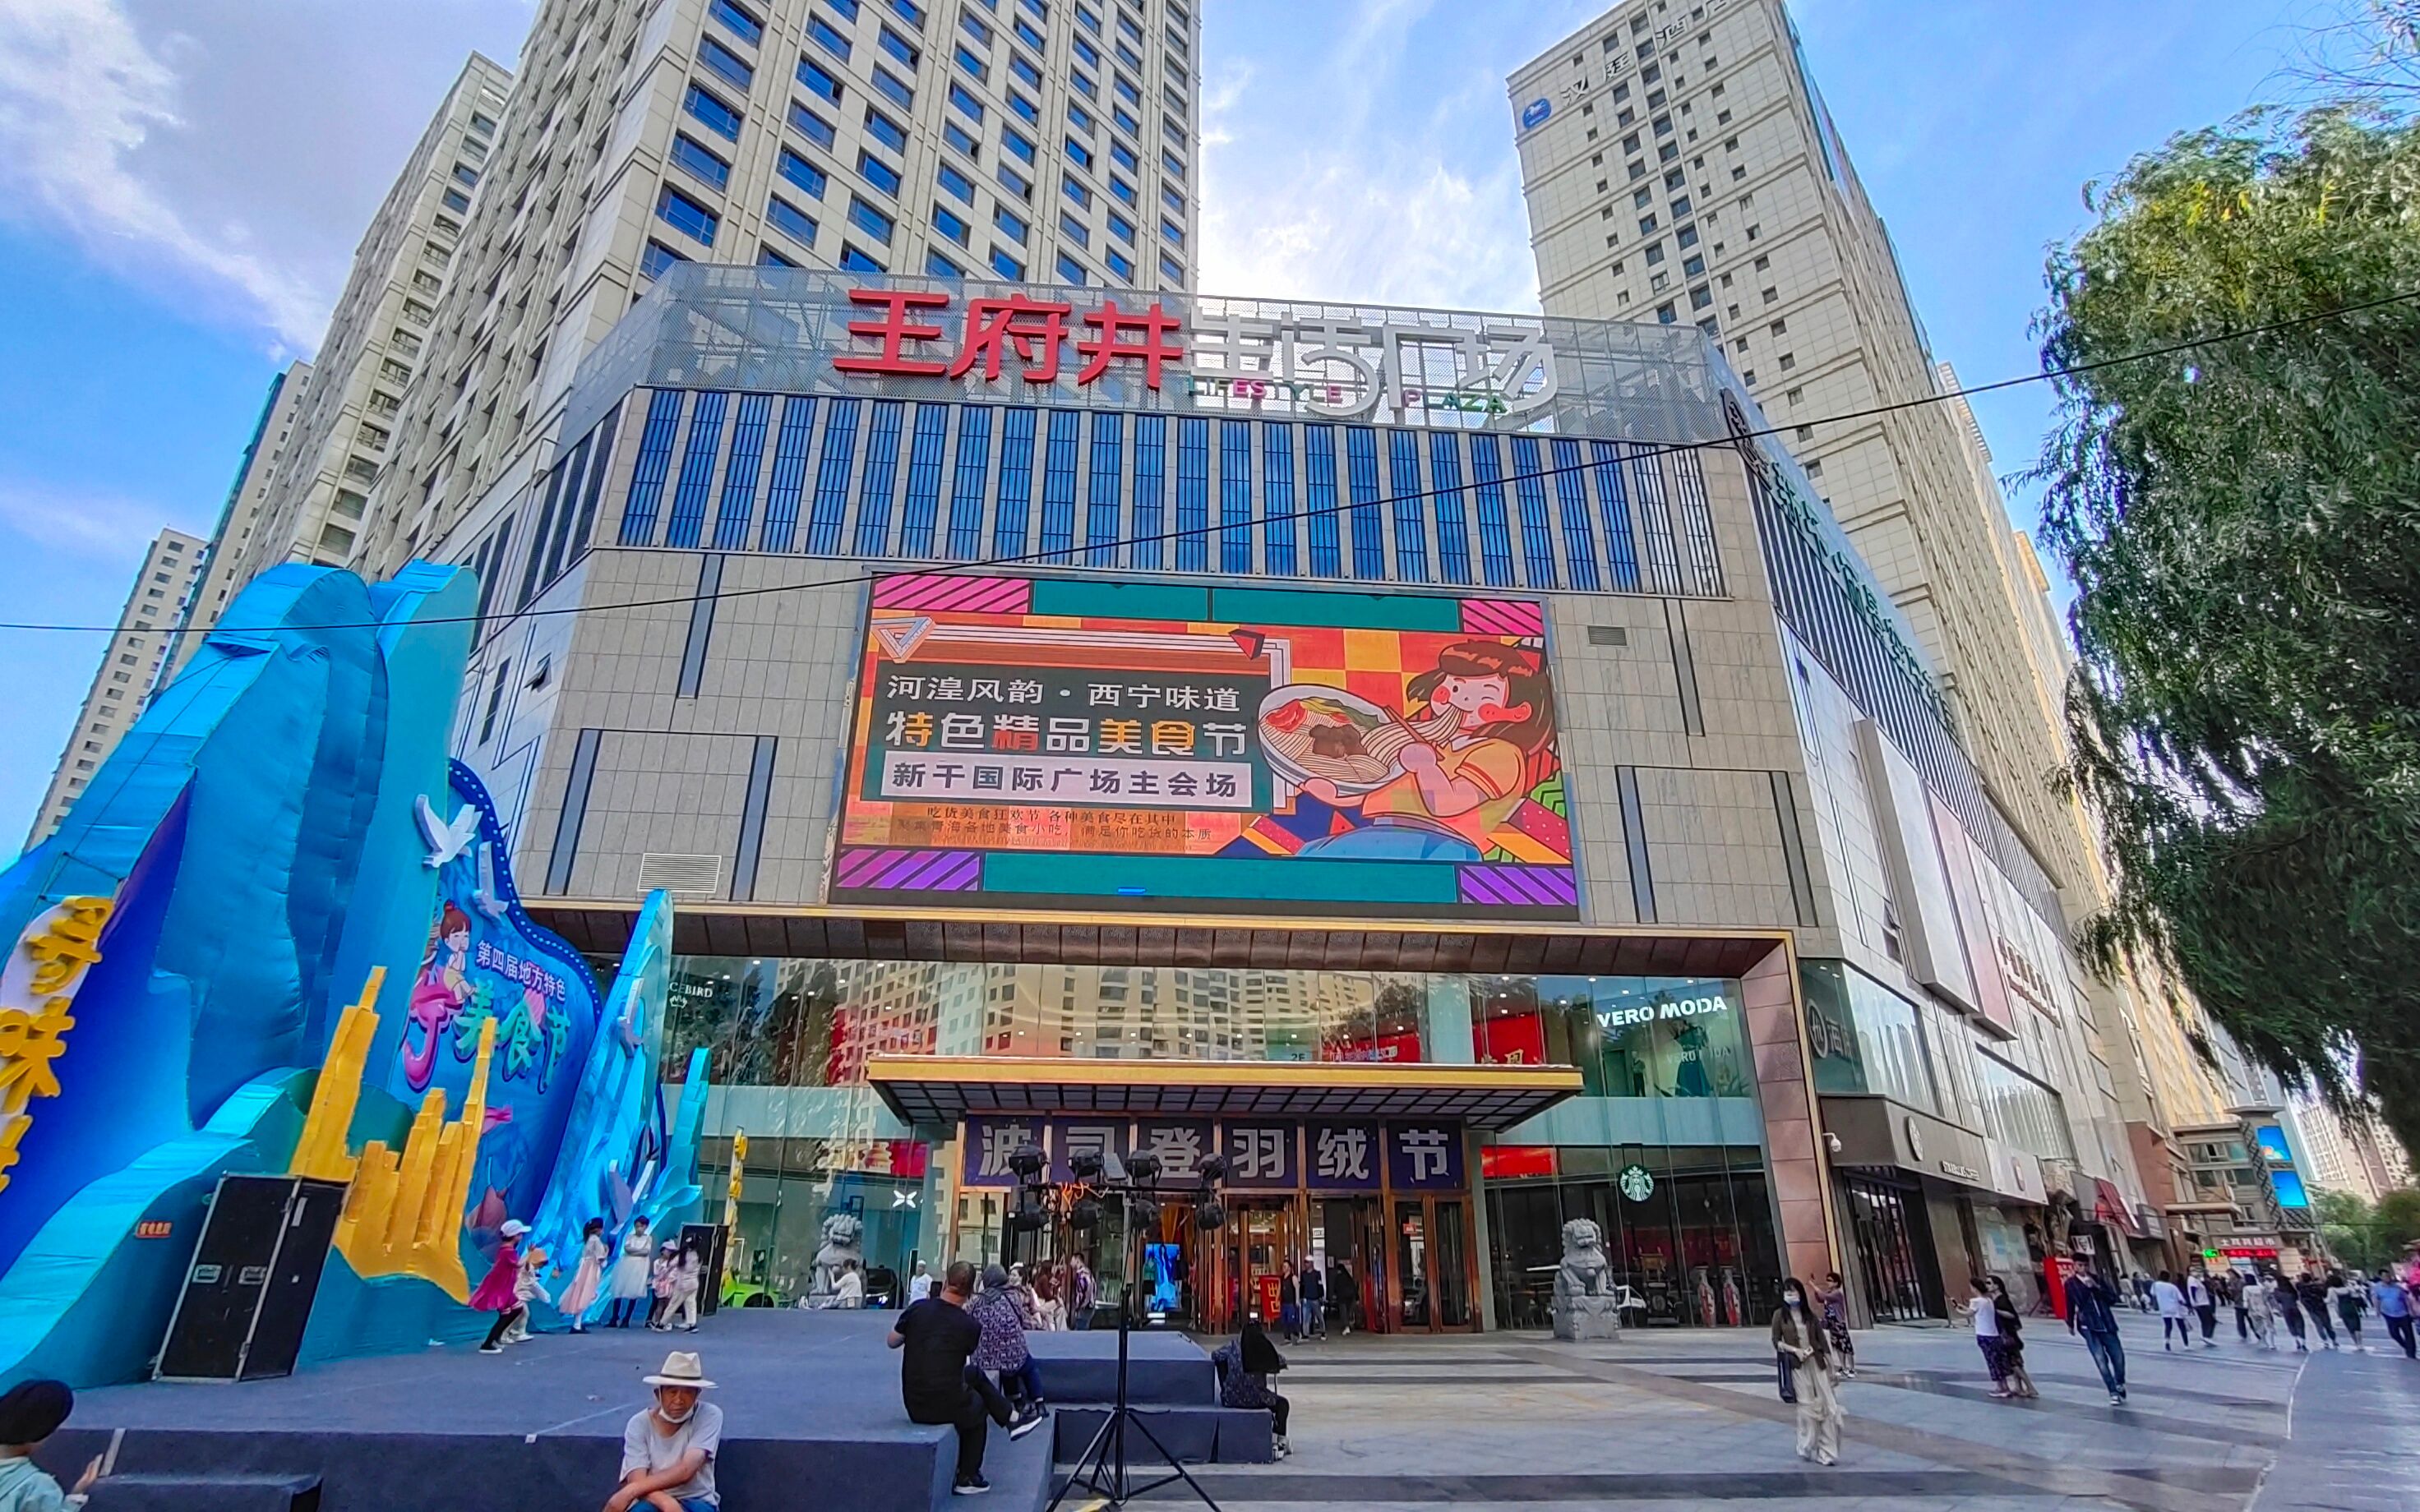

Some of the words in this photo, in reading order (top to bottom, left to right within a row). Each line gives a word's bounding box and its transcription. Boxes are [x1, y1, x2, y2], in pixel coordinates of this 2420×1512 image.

[1187, 376, 1343, 404] LIFESTYLE
[1402, 389, 1508, 413] PLAZA
[884, 711, 1247, 758] 特色精品美食节
[475, 939, 566, 1003] 第四届地方特色
[1596, 1006, 1655, 1028] VERO
[1660, 996, 1727, 1020] MODA
